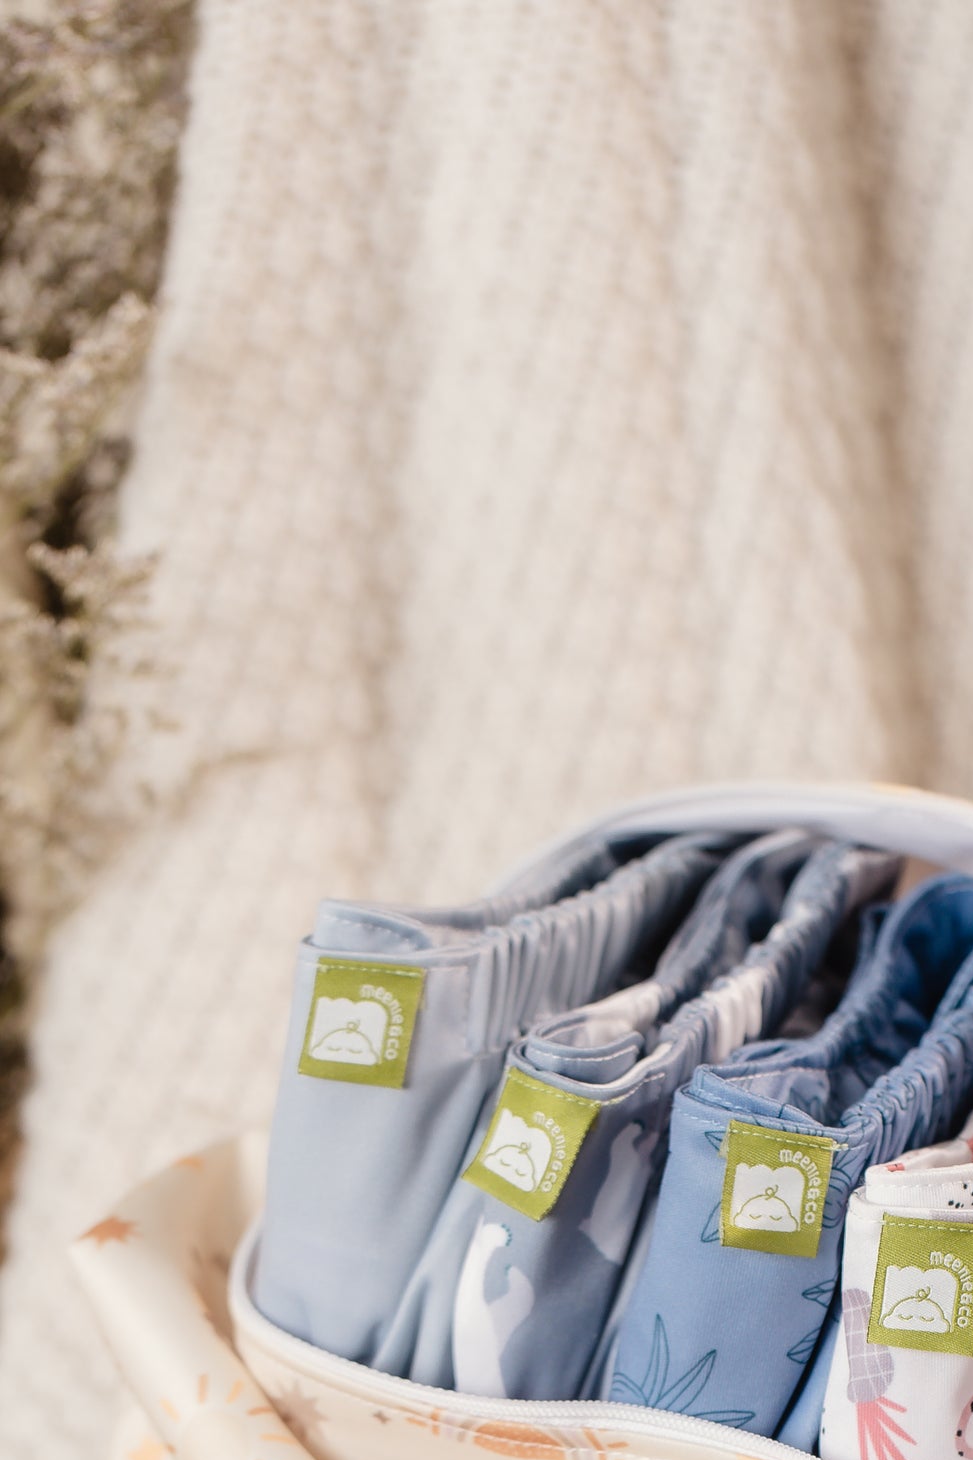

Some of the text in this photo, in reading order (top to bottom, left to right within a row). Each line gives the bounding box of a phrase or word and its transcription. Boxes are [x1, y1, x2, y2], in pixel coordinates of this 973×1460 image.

[360, 984, 400, 1061] meenie&co
[532, 1110, 567, 1193] meenie&co
[780, 1149, 816, 1224] meenie&co
[930, 1250, 972, 1329] meenie&co
